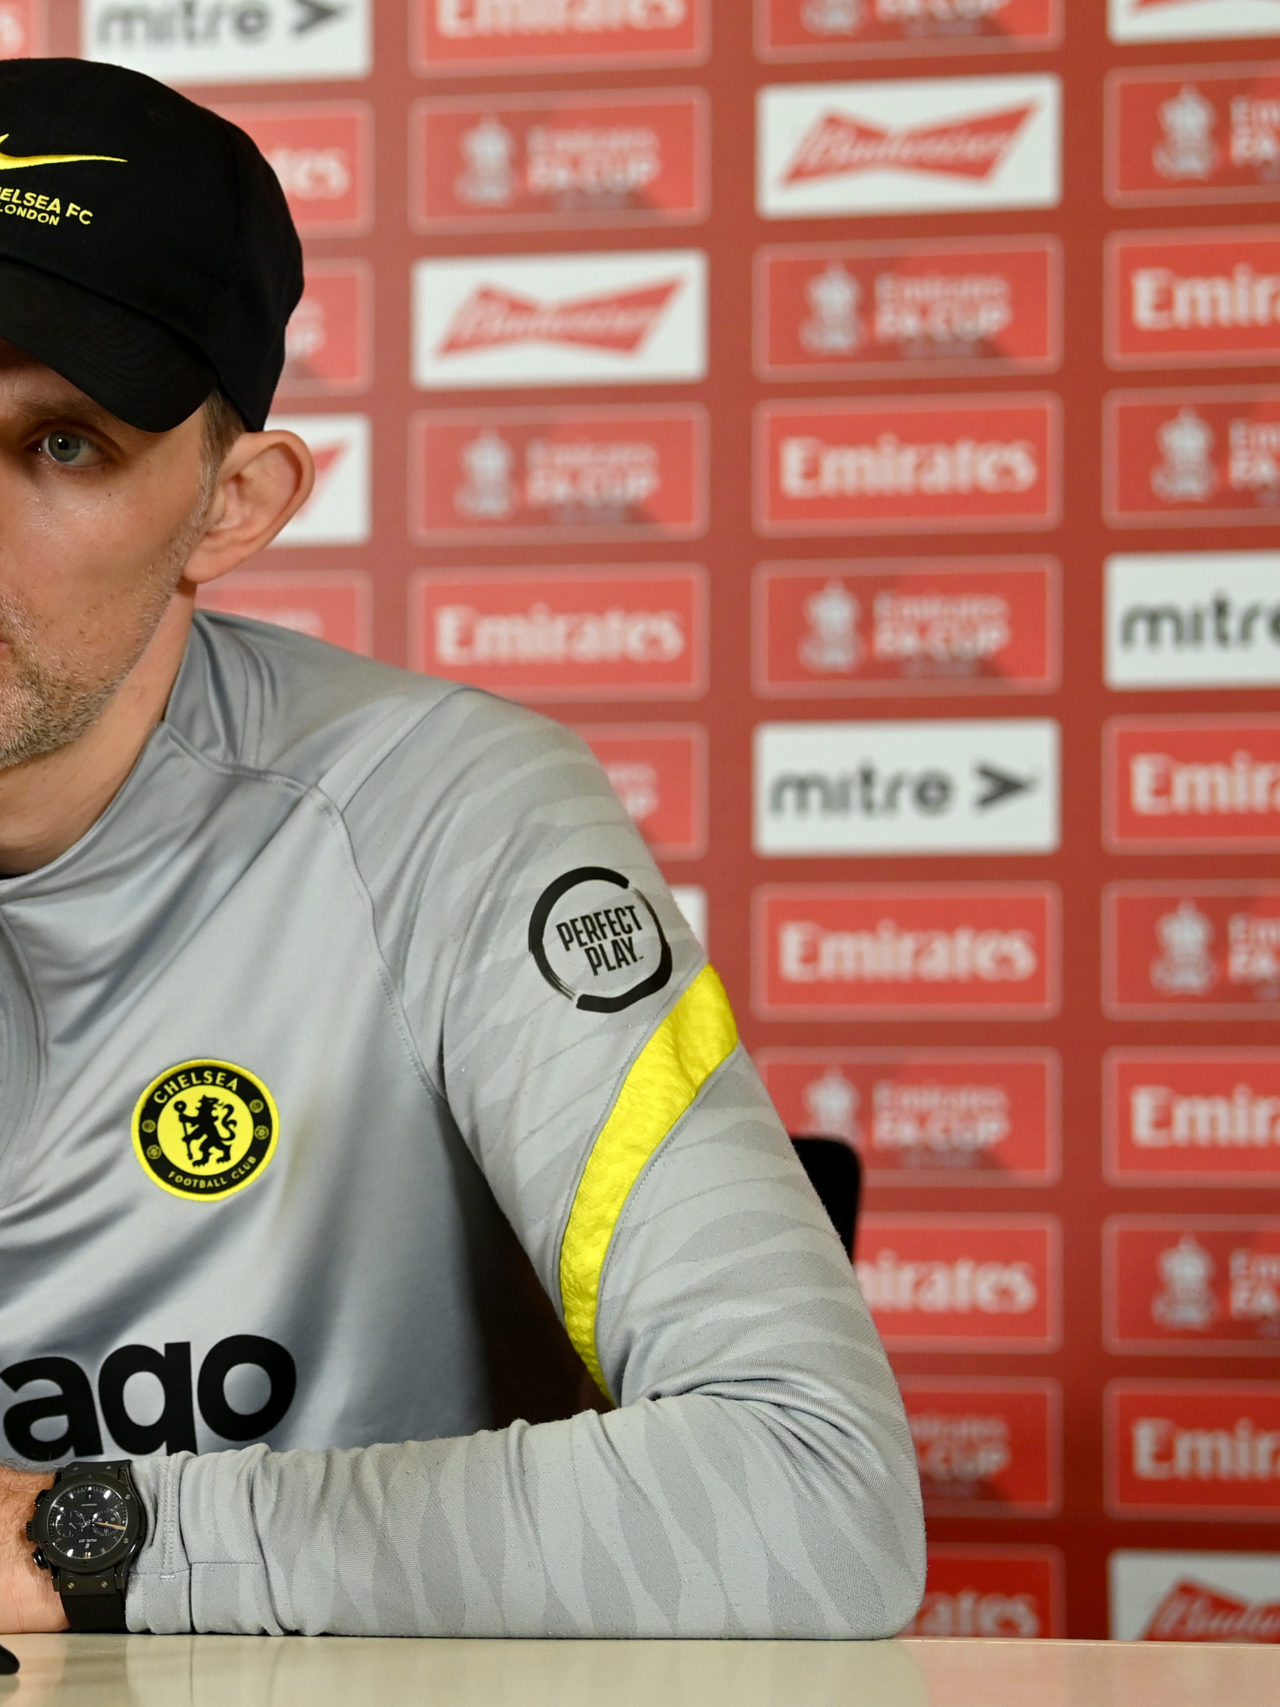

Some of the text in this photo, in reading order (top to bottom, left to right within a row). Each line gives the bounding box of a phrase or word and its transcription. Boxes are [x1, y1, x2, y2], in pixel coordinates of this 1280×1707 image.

[65, 202, 94, 225] FC
[781, 434, 1035, 497] Emirates
[436, 605, 685, 666] Emirates
[770, 760, 953, 817] mitre
[556, 905, 642, 952] PERFECT
[780, 919, 1036, 983] Emirates
[153, 1070, 238, 1104] CHELSEA
[168, 1155, 257, 1189] FOOTBALL CLUB
[857, 1249, 1037, 1314] irates
